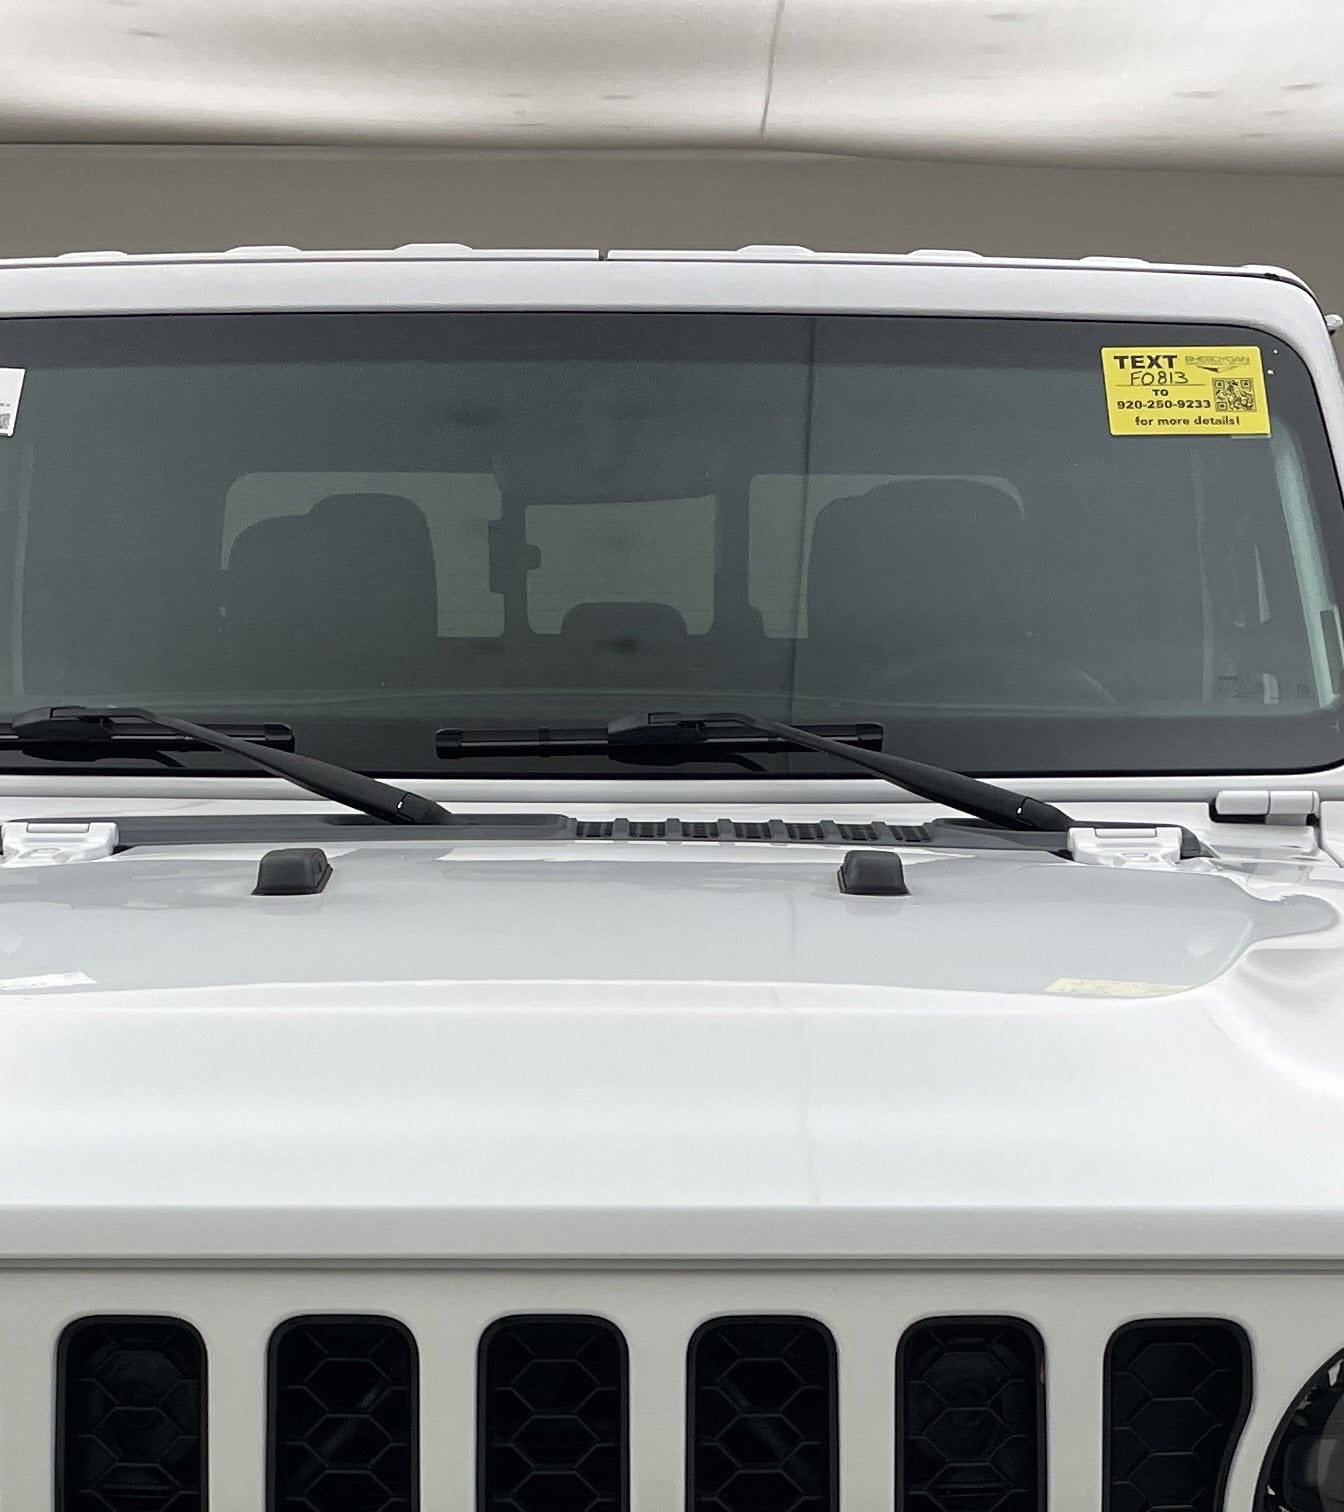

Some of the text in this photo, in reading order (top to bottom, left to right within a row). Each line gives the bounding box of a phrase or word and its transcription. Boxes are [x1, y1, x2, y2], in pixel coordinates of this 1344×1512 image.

[1113, 354, 1178, 369] TEXT
[1151, 388, 1169, 397] TO
[1135, 416, 1153, 426] for
[1157, 417, 1190, 426] more
